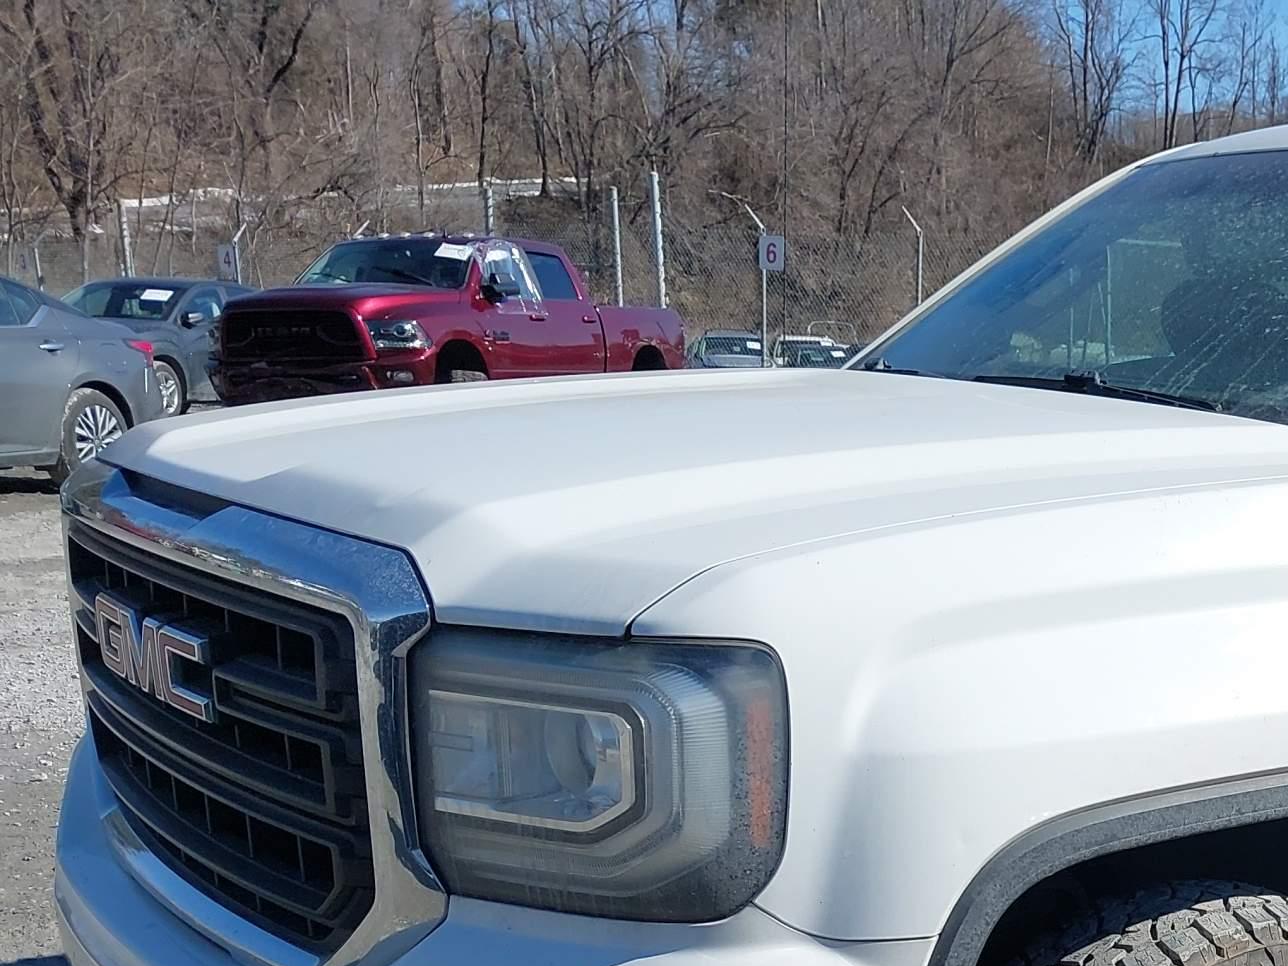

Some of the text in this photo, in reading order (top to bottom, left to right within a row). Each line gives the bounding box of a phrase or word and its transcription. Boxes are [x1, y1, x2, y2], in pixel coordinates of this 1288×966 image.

[223, 250, 233, 269] 4
[766, 242, 777, 264] 6
[95, 592, 214, 723] GMC
